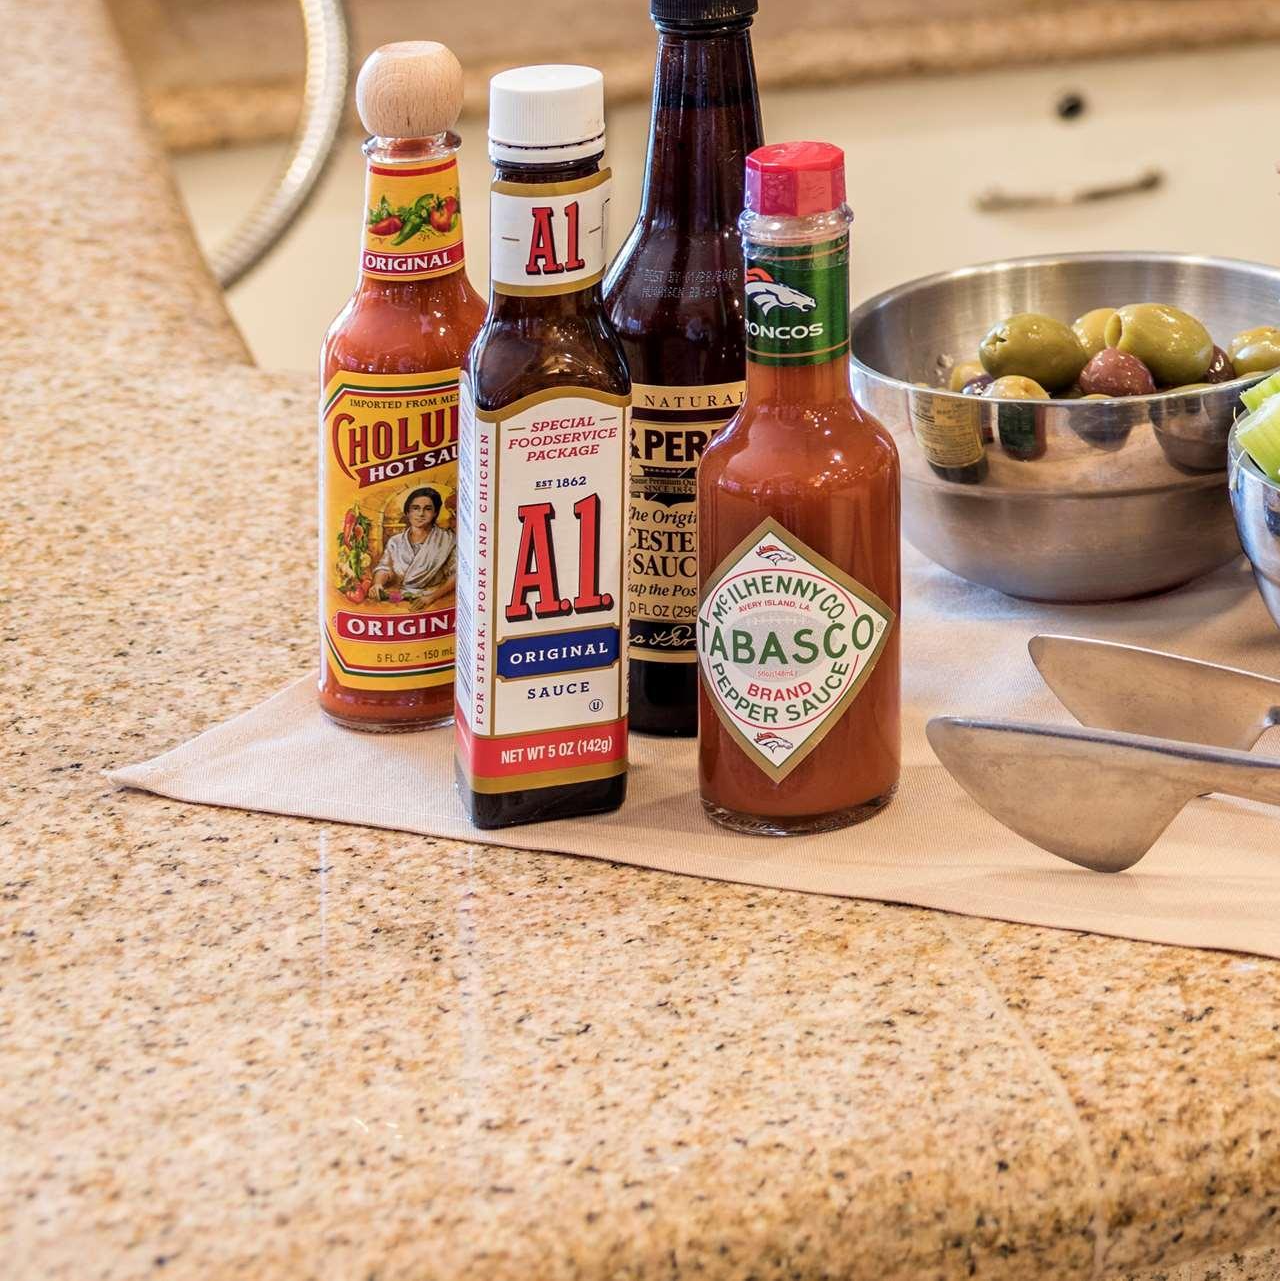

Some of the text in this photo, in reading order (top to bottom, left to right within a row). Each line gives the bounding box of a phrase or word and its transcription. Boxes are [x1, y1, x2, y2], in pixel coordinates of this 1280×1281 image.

[365, 252, 452, 271] ORIGINAL
[350, 398, 402, 409] IMPORTED
[406, 398, 438, 408] FROM
[531, 416, 595, 432] SPECIAL
[508, 427, 618, 449] FOODSERVICE
[645, 429, 720, 462] PER
[526, 444, 600, 462] PACKAGE
[369, 457, 417, 482] HOT
[535, 476, 587, 489] EST 1862
[652, 510, 697, 528] Origi
[476, 434, 490, 726] FOR STEAK, PORK AND CHICKEN
[649, 584, 669, 598] the
[638, 603, 649, 616] FL
[652, 605, 669, 618] OZ
[739, 600, 762, 613] AVERY
[764, 600, 799, 609] ISLAND,
[819, 593, 846, 623] CO.
[347, 614, 456, 636] ORIGIN
[699, 614, 874, 665] TABASCO
[376, 653, 382, 663] 5
[424, 649, 440, 661] 150
[510, 642, 609, 665] ORIGINAL
[528, 682, 590, 700] SAUCE
[712, 661, 850, 723] PEPPER SAUCE
[747, 681, 812, 702] BRAND
[501, 736, 612, 764] NET WT 5 OZ (142g)
